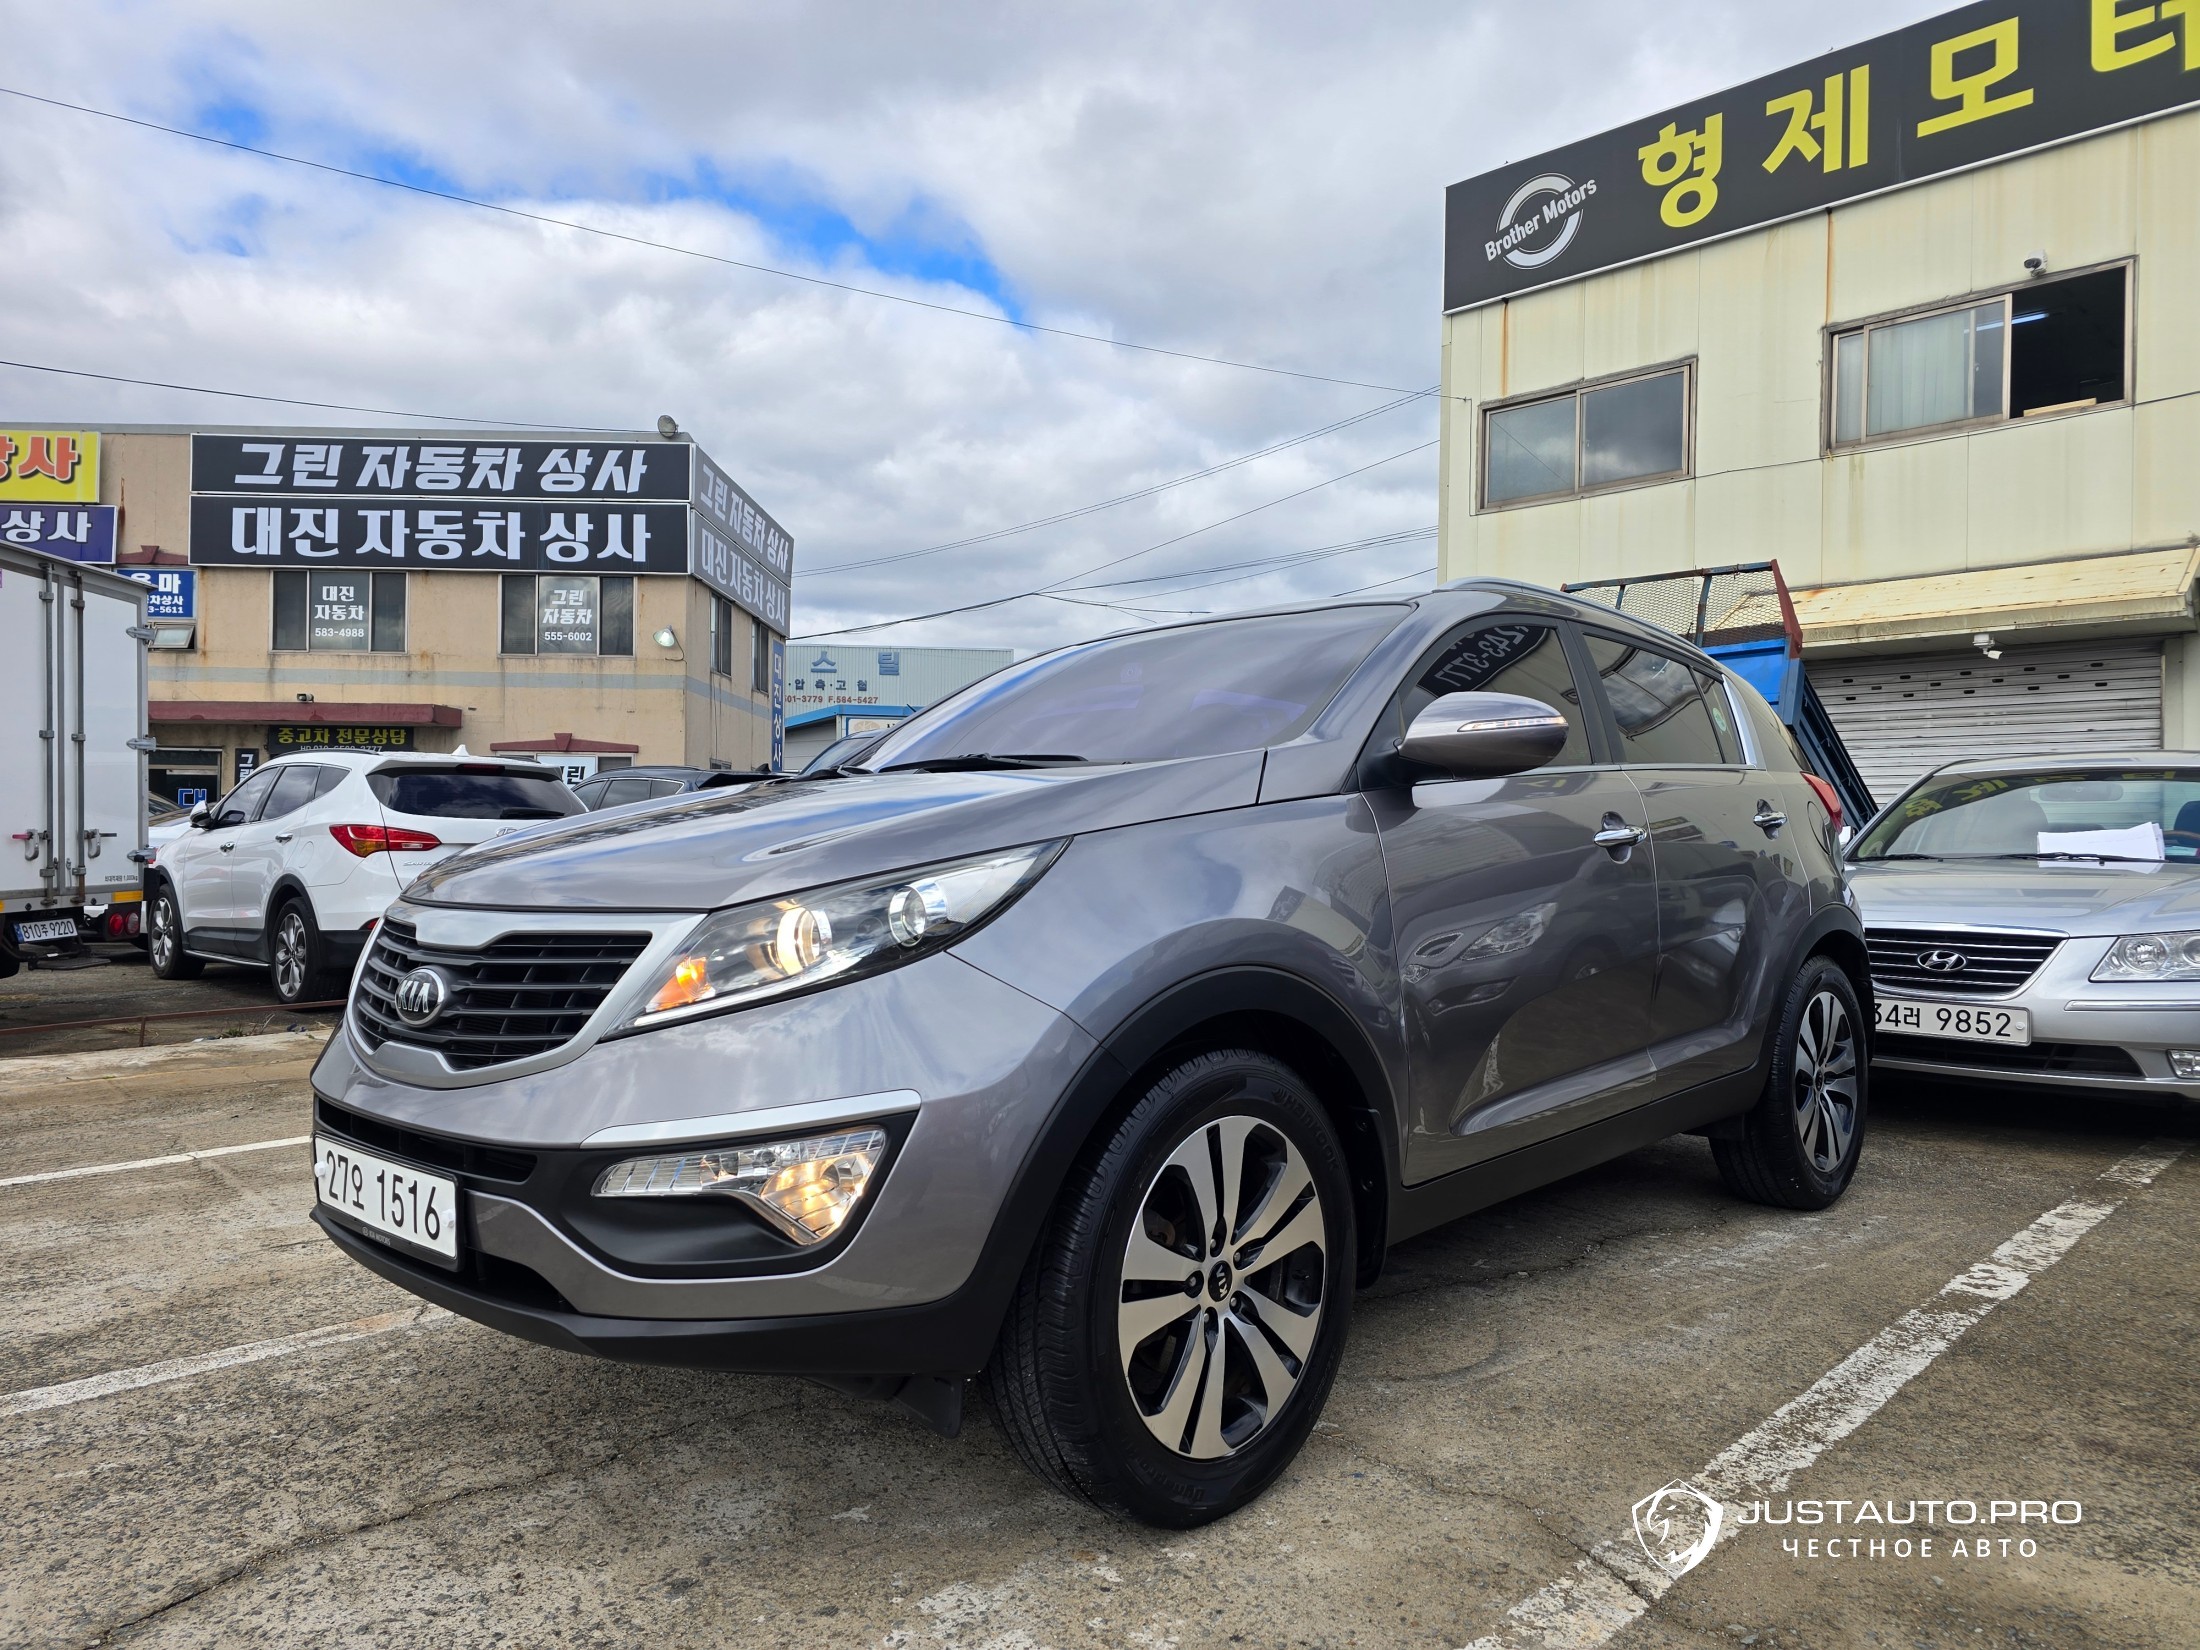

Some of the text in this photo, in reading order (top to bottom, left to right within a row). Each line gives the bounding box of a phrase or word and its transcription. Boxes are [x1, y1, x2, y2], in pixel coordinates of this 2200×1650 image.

[1485, 179, 1597, 261] Brother Motors
[0, 435, 78, 481] 사
[234, 443, 648, 493] 그린 자동차 상사
[1, 510, 92, 543] 상사
[700, 463, 789, 574] 그린 자동차 상사
[231, 506, 652, 562] 대진 자동차 상사
[701, 527, 786, 627] 대진 자동차 상사
[147, 594, 184, 606] 차상사
[322, 585, 355, 602] 대진
[551, 589, 584, 606] 그린
[314, 604, 365, 621] 자동차
[542, 608, 593, 625] 자동차
[314, 627, 365, 638] 583-4988
[544, 631, 592, 641] 555-6002
[784, 695, 823, 703] 01-3779
[277, 727, 407, 745] 중고차 전문상담
[21, 920, 75, 939] 810주 9220
[398, 979, 431, 1014] KIA
[1936, 1008, 2012, 1037] 9852
[326, 1149, 441, 1241] 27오 1516
